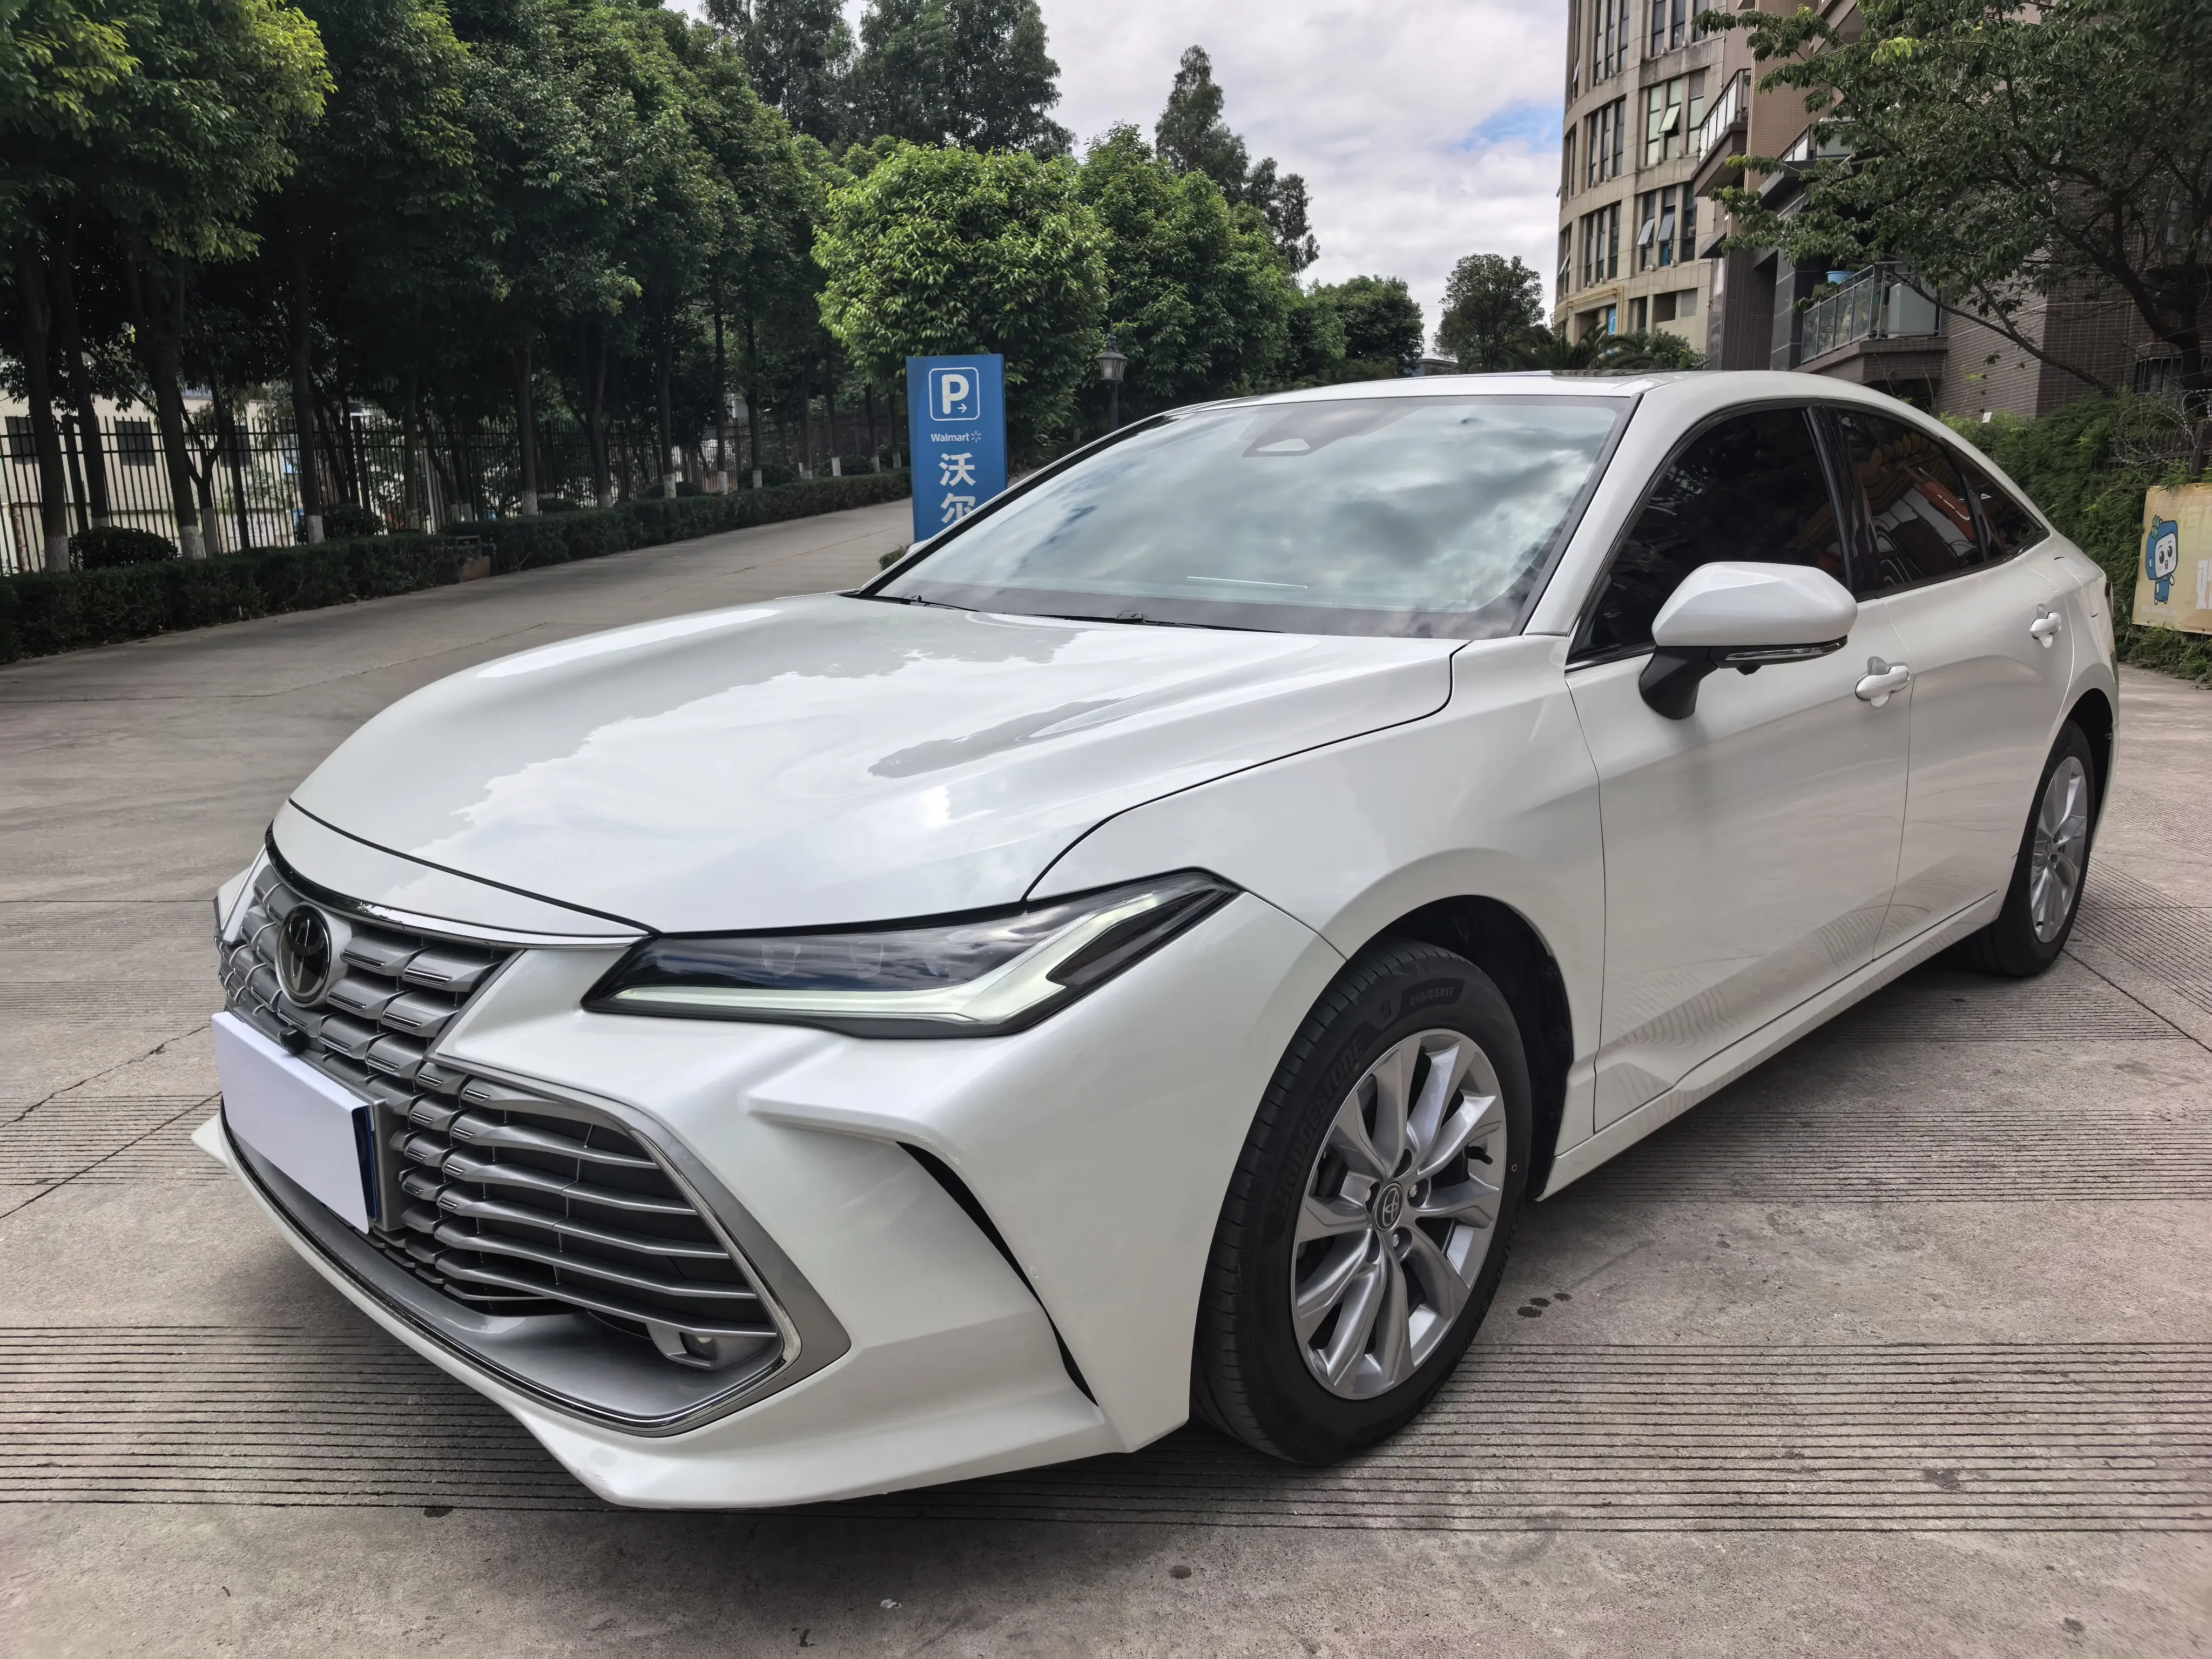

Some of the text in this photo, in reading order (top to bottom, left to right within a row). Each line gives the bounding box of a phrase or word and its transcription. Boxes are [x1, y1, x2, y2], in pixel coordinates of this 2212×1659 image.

[942, 374, 969, 414] P
[930, 433, 970, 442] Walmart
[1271, 1036, 1364, 1219] BRIDGESTONE
